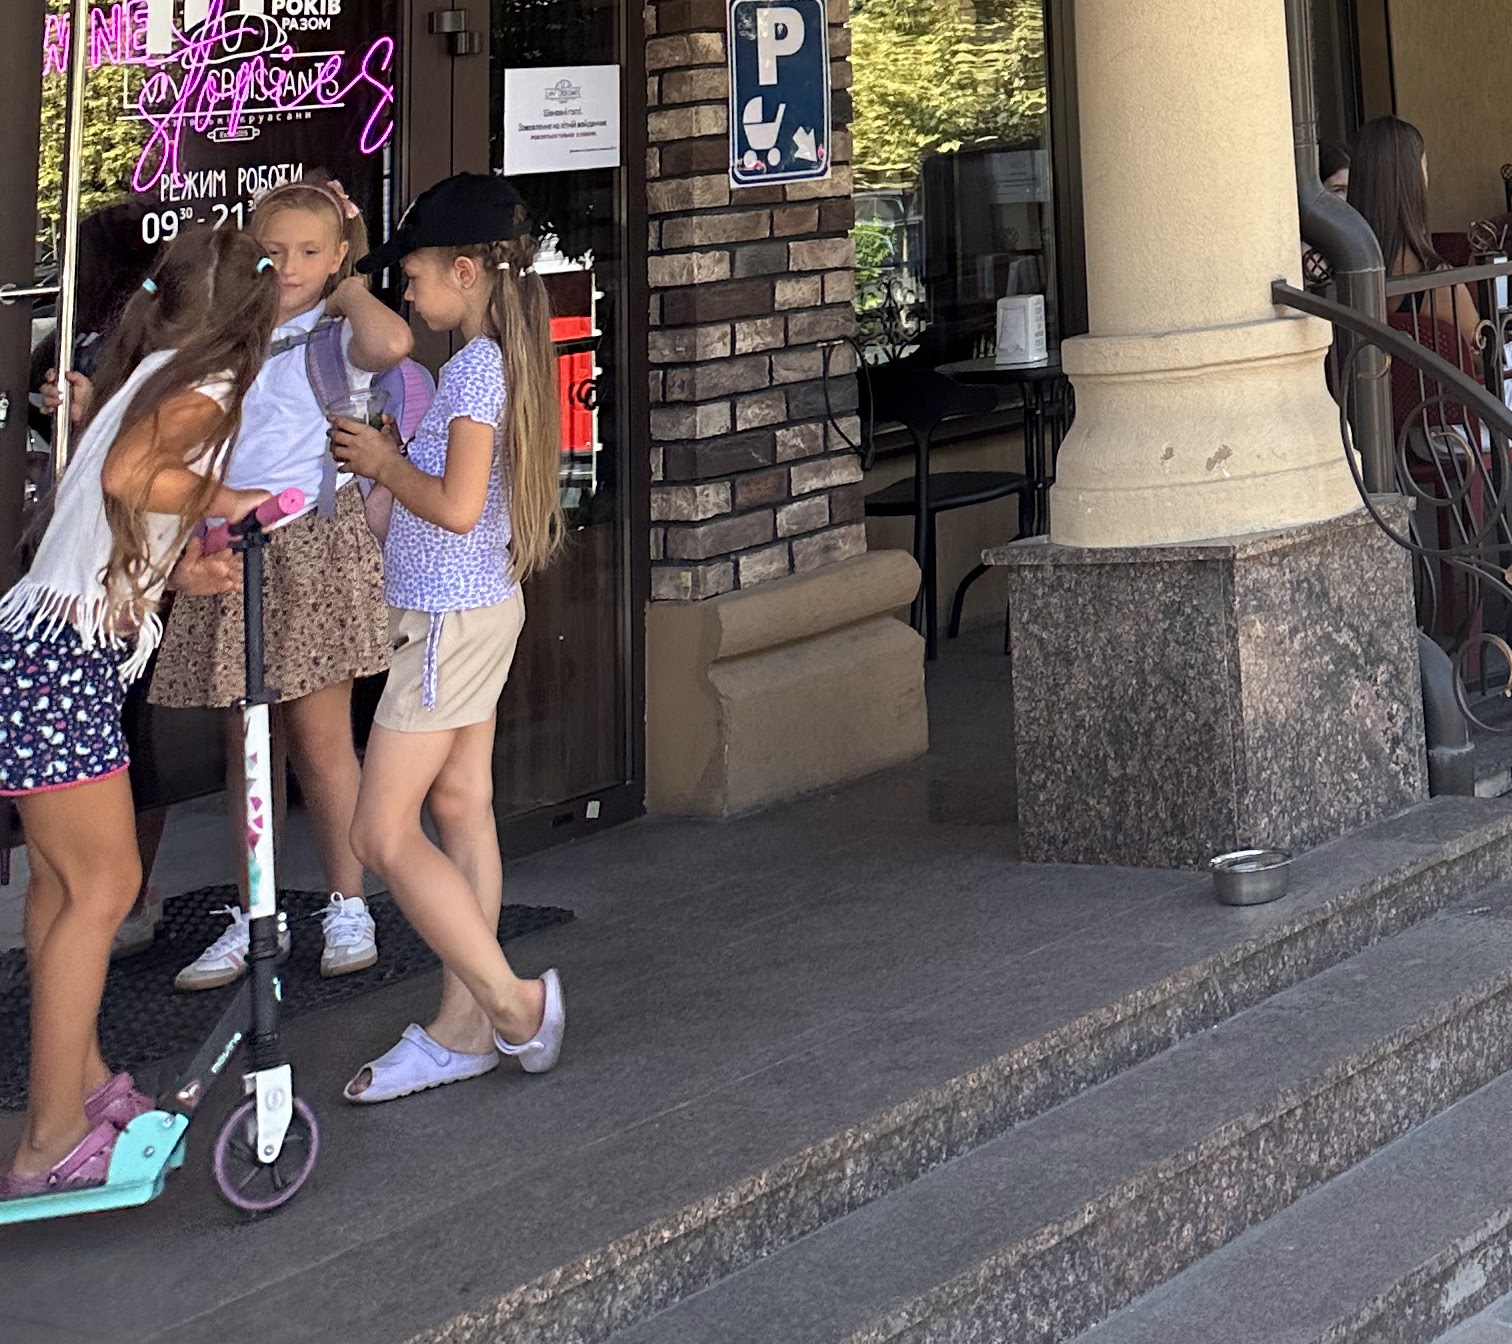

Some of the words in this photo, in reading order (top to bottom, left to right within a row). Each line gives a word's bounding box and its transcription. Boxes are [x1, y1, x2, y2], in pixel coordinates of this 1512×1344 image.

[281, 17, 332, 31] РАЗОМ
[160, 169, 227, 203] РЕЖИМ
[238, 162, 303, 196] РОБОТИ
